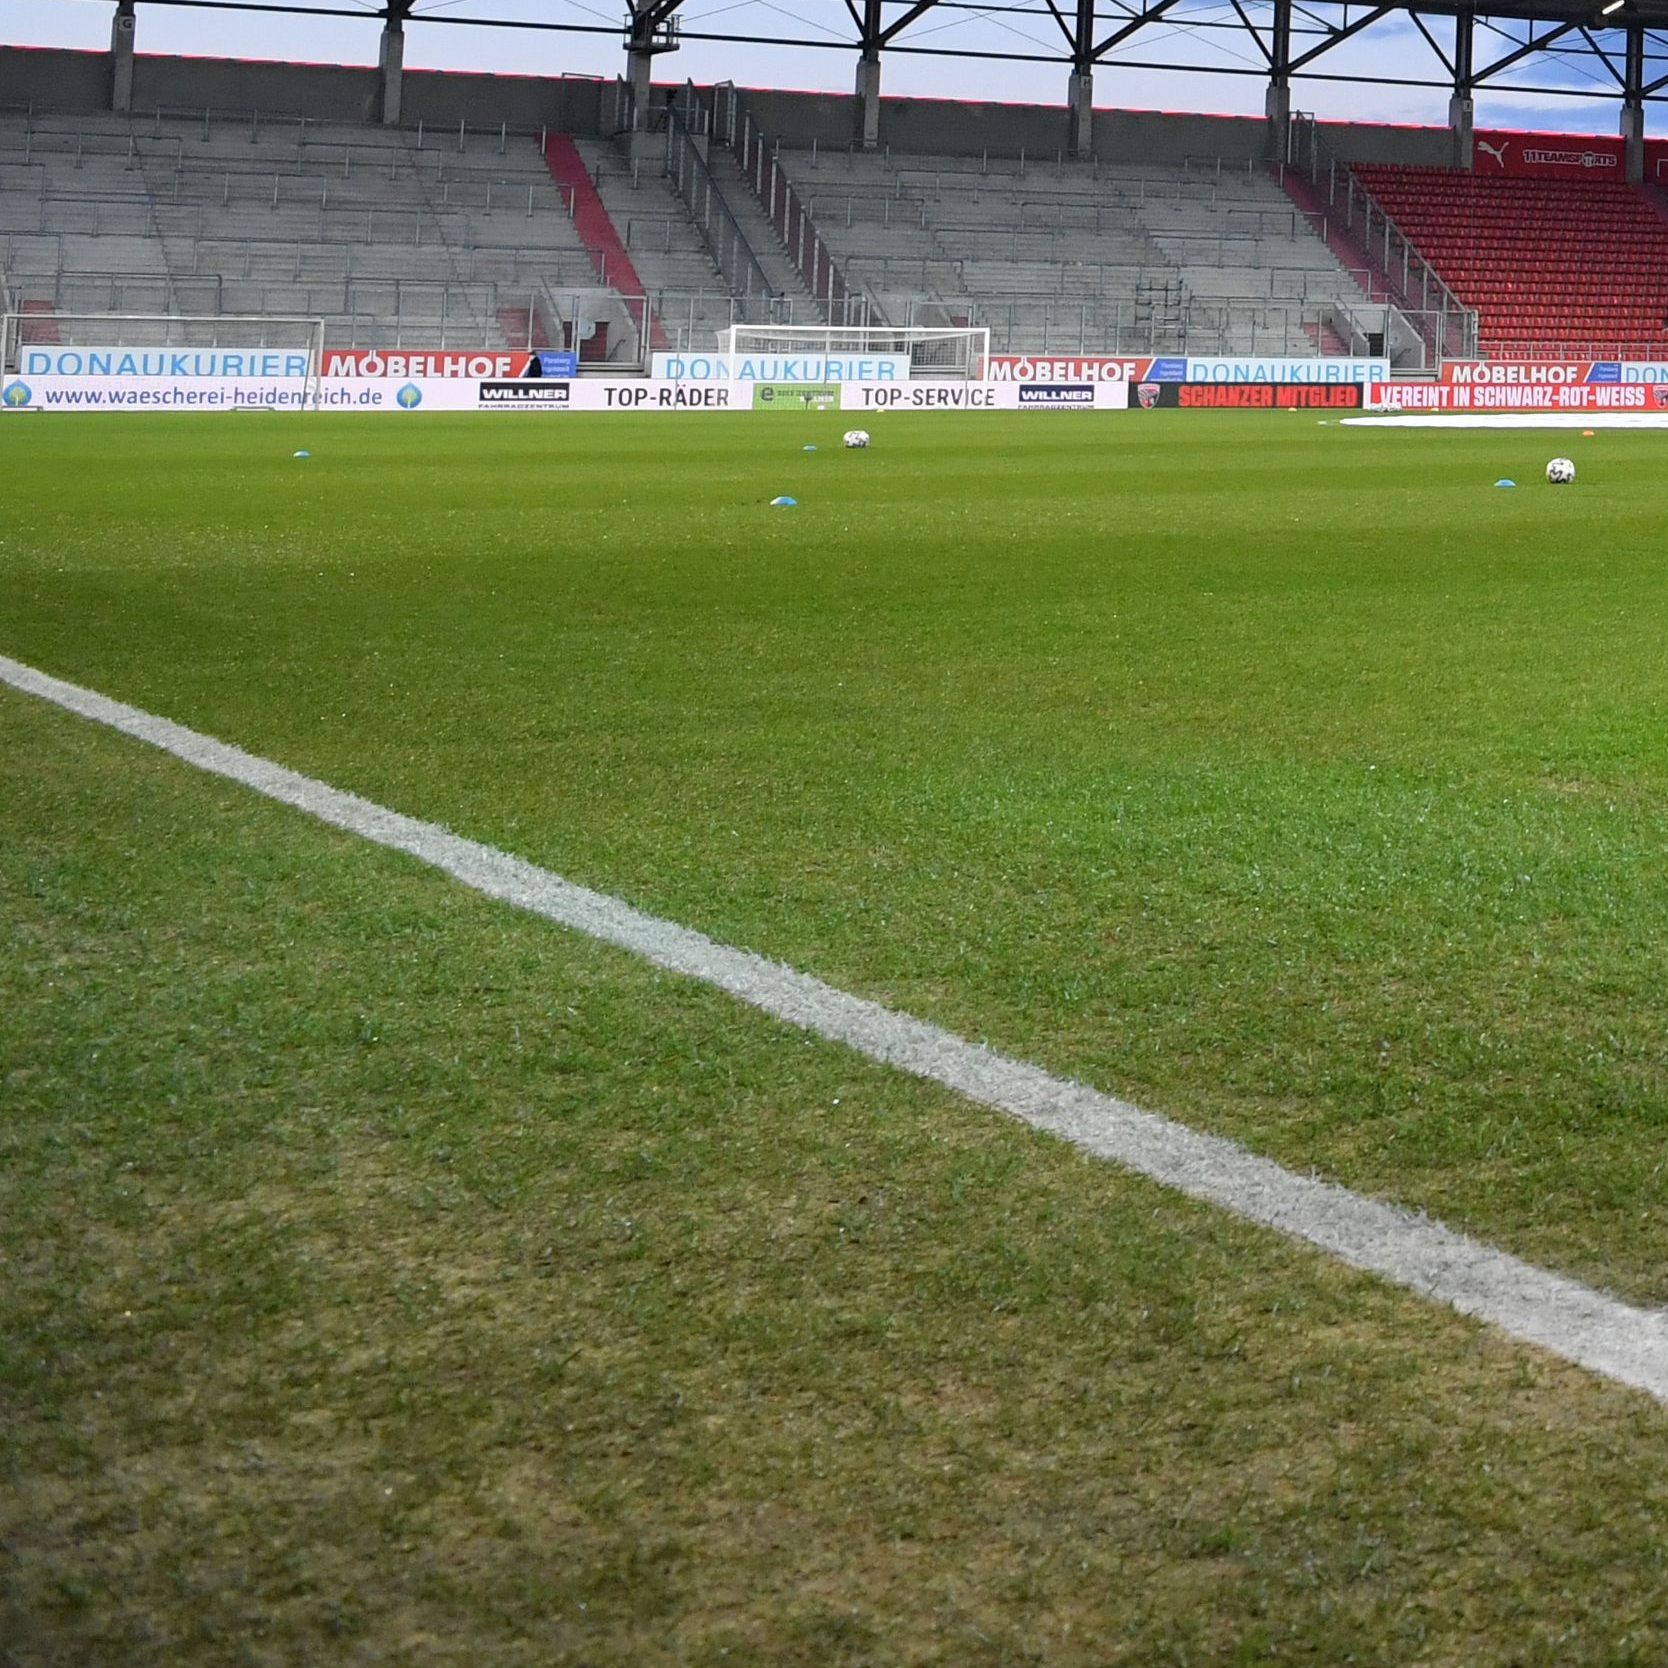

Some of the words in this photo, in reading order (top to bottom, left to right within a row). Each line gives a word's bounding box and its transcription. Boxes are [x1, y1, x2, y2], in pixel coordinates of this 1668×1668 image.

[27, 352, 306, 377] DONAUKURIER
[327, 350, 512, 378] MÖBELHOF
[666, 358, 895, 381] DONAUKURIER
[989, 356, 1136, 382] MÖBELHOF
[1192, 363, 1384, 382] DONAUKURIER
[1452, 362, 1578, 383] MÖBELHOF
[45, 387, 382, 405] www.waescherei-heidenreich.de
[482, 389, 567, 400] WILLNER
[604, 384, 729, 406] TOP-RÄDER
[862, 388, 995, 407] TOP-SERVICE
[1021, 390, 1092, 401] WILLNER
[1178, 385, 1272, 407] SCHANZER
[1276, 385, 1357, 407] MITGLIED
[1379, 386, 1449, 408] VEREINT
[1453, 387, 1470, 407] IN
[1474, 386, 1645, 407] SCHWARZ-ROT-WEISS
